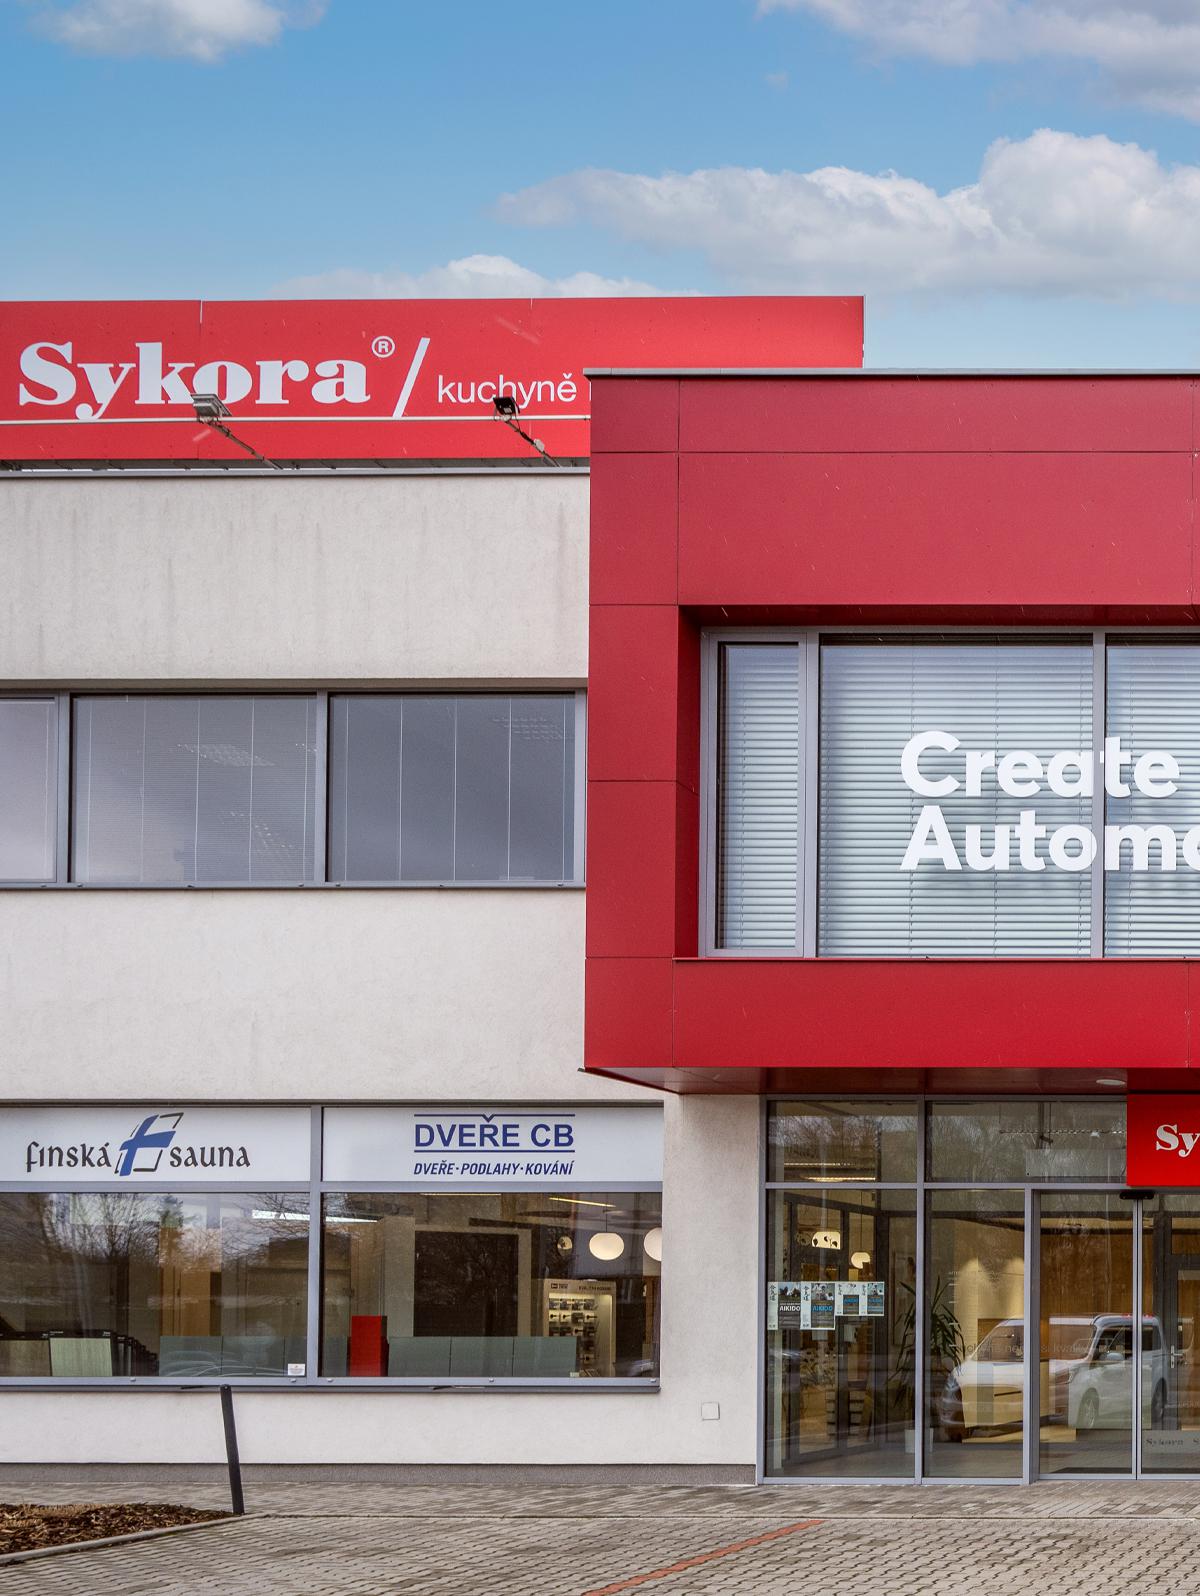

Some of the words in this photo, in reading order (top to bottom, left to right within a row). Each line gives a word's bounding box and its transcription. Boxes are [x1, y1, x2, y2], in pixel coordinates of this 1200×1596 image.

[438, 372, 577, 409] kuchyně
[900, 730, 1180, 798] Create
[415, 1115, 520, 1147] DVEŘE
[530, 1123, 575, 1147] CB
[170, 1145, 250, 1168] sauna
